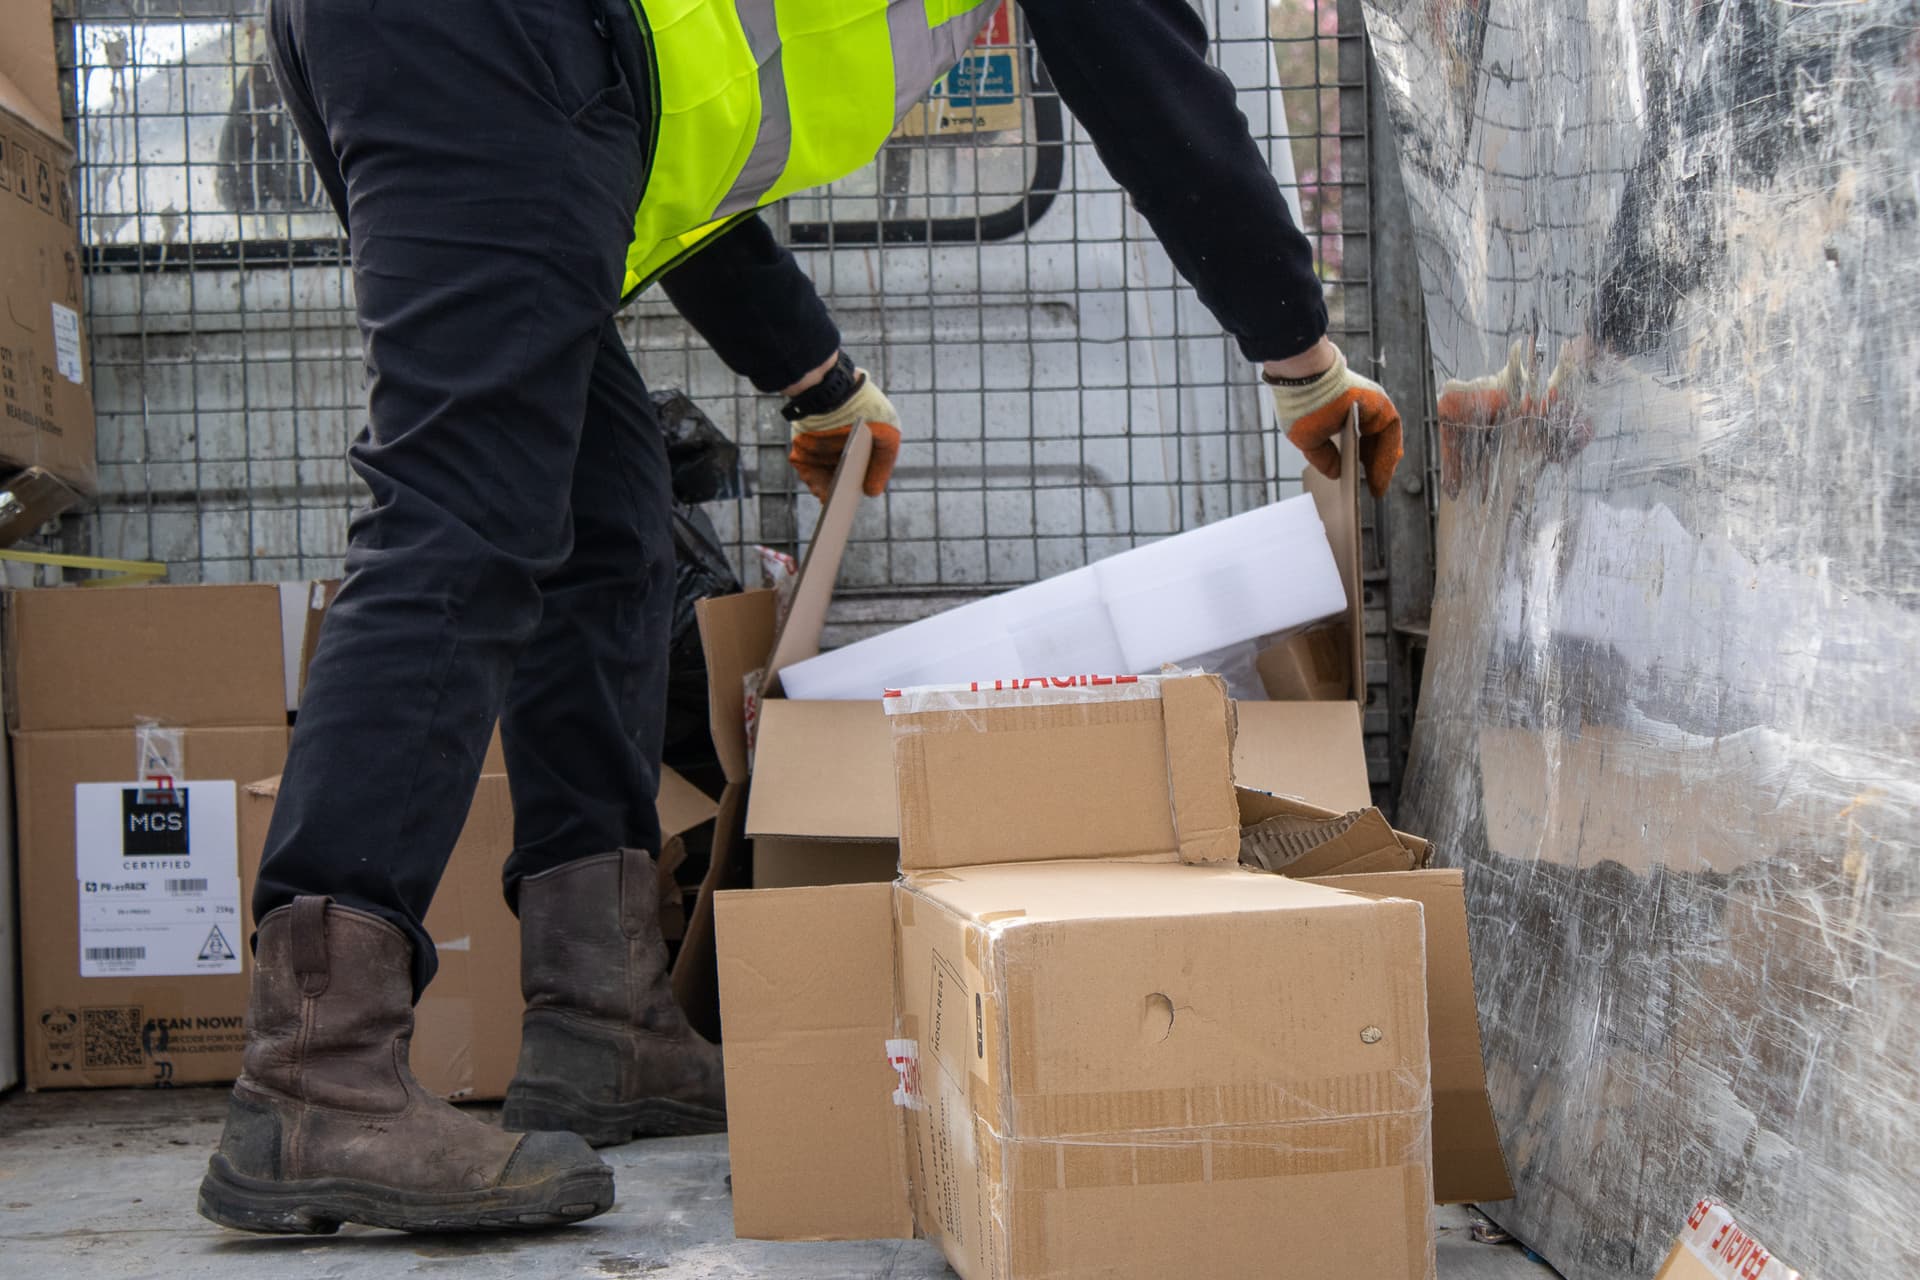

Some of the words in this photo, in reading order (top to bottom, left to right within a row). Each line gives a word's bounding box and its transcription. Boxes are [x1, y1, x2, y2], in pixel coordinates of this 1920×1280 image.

[129, 812, 183, 832] MCS
[123, 861, 191, 871] CERTIFIED
[936, 970, 944, 1007] REST
[195, 1015, 243, 1029] NOW!
[934, 1008, 943, 1052] HOOK
